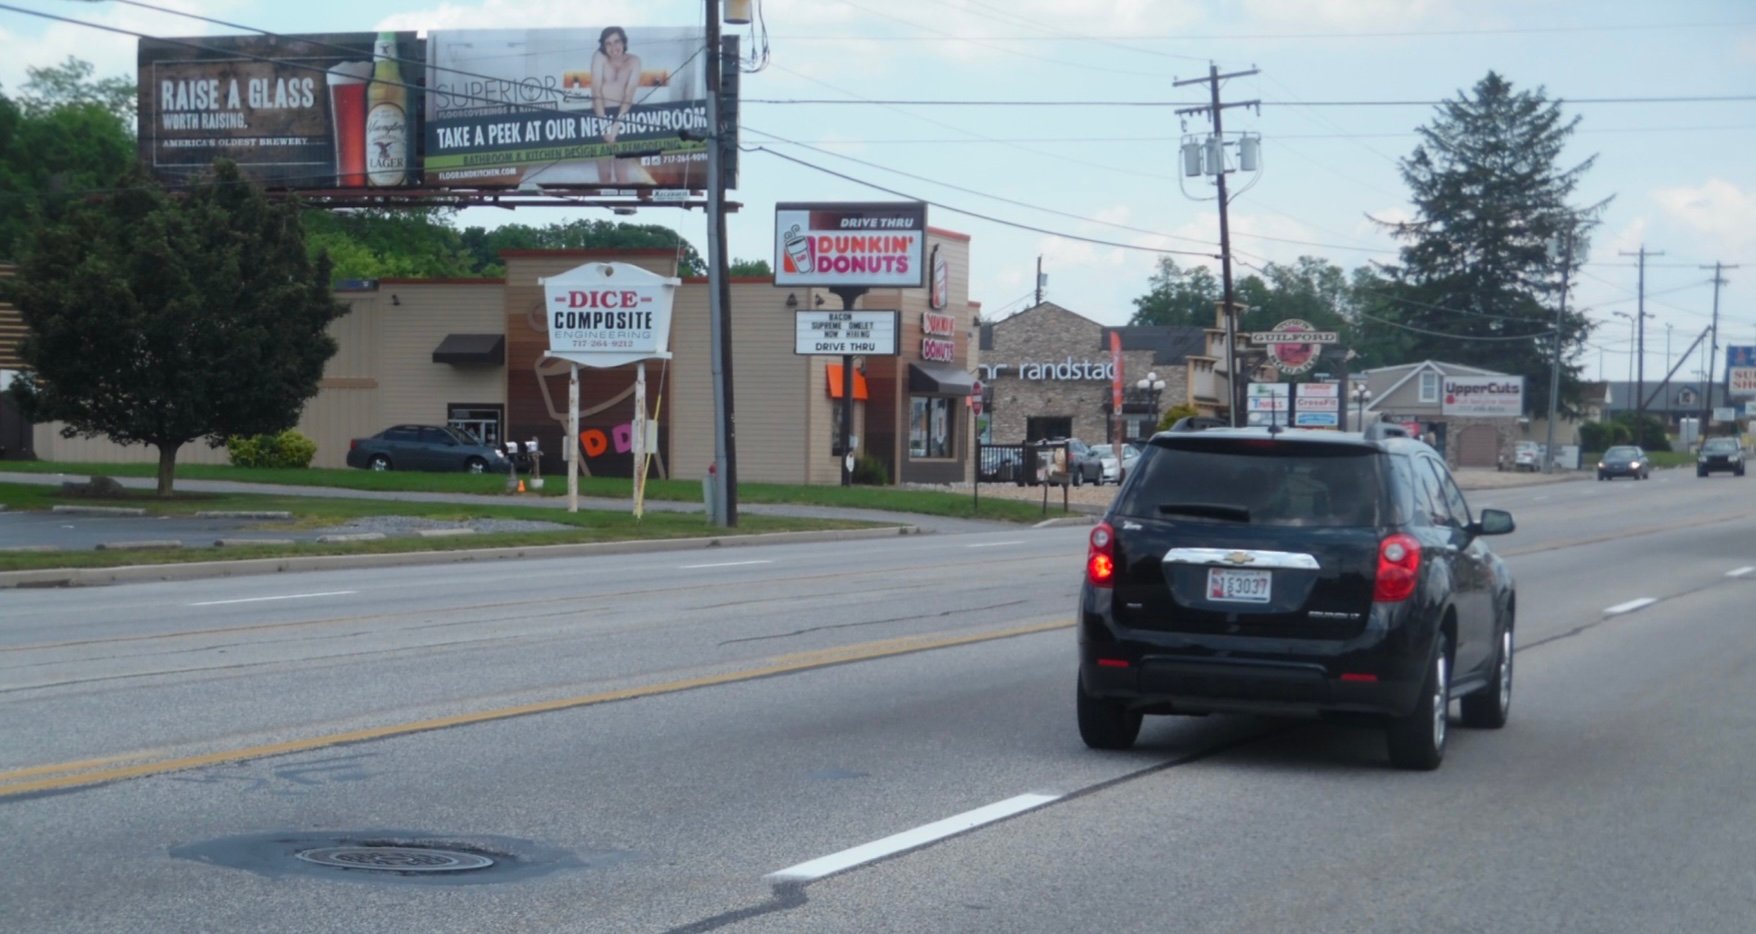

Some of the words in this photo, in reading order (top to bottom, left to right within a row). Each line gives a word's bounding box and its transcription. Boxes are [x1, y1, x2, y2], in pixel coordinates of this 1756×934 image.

[161, 79, 219, 111] RAISE
[227, 79, 241, 110] A
[248, 77, 314, 109] GLASS
[436, 75, 558, 110] SUPERIOR
[162, 113, 199, 130] WORTH
[202, 112, 248, 129] RAISING.
[437, 126, 471, 149] TAKE
[474, 125, 485, 146] A
[488, 122, 521, 145] PEEK
[525, 120, 541, 142] AT
[545, 118, 576, 141] OUR
[580, 115, 612, 138] NEW
[618, 106, 708, 135] SHOWROOM
[163, 139, 216, 148] AMERICA'S
[218, 138, 257, 147] OLDEST
[463, 152, 513, 166] BATHROOM
[526, 148, 561, 162] KITCHEN
[564, 145, 596, 158] DESIGN
[600, 143, 619, 155] AND
[369, 157, 405, 168] LAGER
[840, 217, 878, 227] DRIVE
[880, 217, 914, 227] THRU
[817, 235, 914, 254] DUNKIN'
[817, 255, 909, 273] DONUTS
[568, 291, 638, 308] DICE
[554, 312, 652, 329] COMPOSITE
[829, 313, 852, 321] BACON
[811, 321, 842, 330] SUPREME
[848, 321, 874, 330] OMELET
[554, 331, 651, 339] ENGINEERING
[824, 330, 839, 338] NOW
[846, 330, 871, 338] HIRING
[1253, 333, 1336, 342] GUILFORD
[815, 342, 846, 351] DRIVE
[850, 342, 876, 351] THRU
[1445, 382, 1520, 397] UpperCuts
